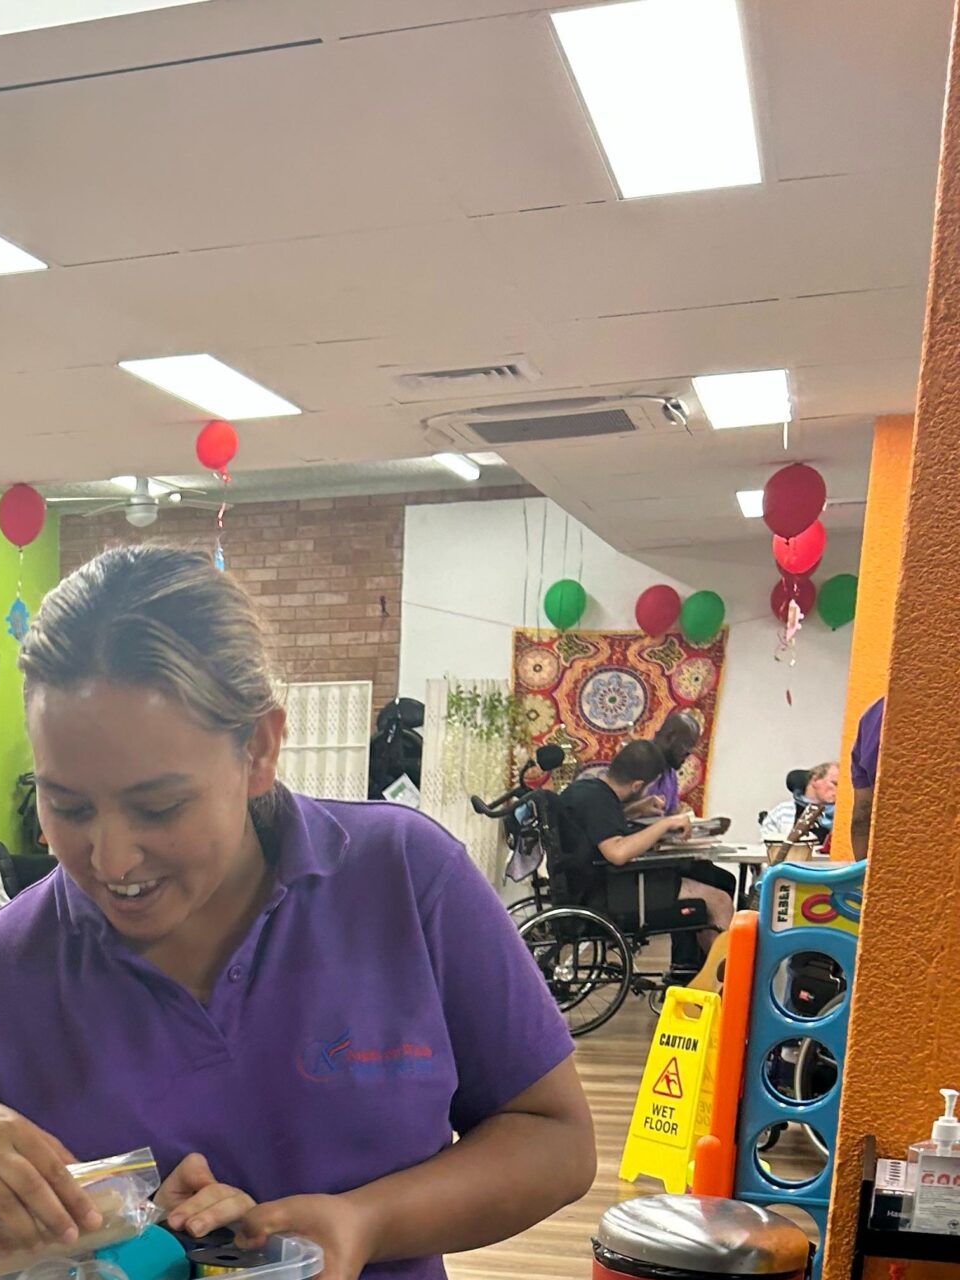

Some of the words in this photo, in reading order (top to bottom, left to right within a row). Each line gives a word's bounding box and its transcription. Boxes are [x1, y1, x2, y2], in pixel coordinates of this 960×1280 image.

[777, 885, 791, 922] FEBER
[658, 1033, 699, 1052] CAUTION
[652, 1103, 675, 1119] WET
[644, 1116, 679, 1136] FLOOR
